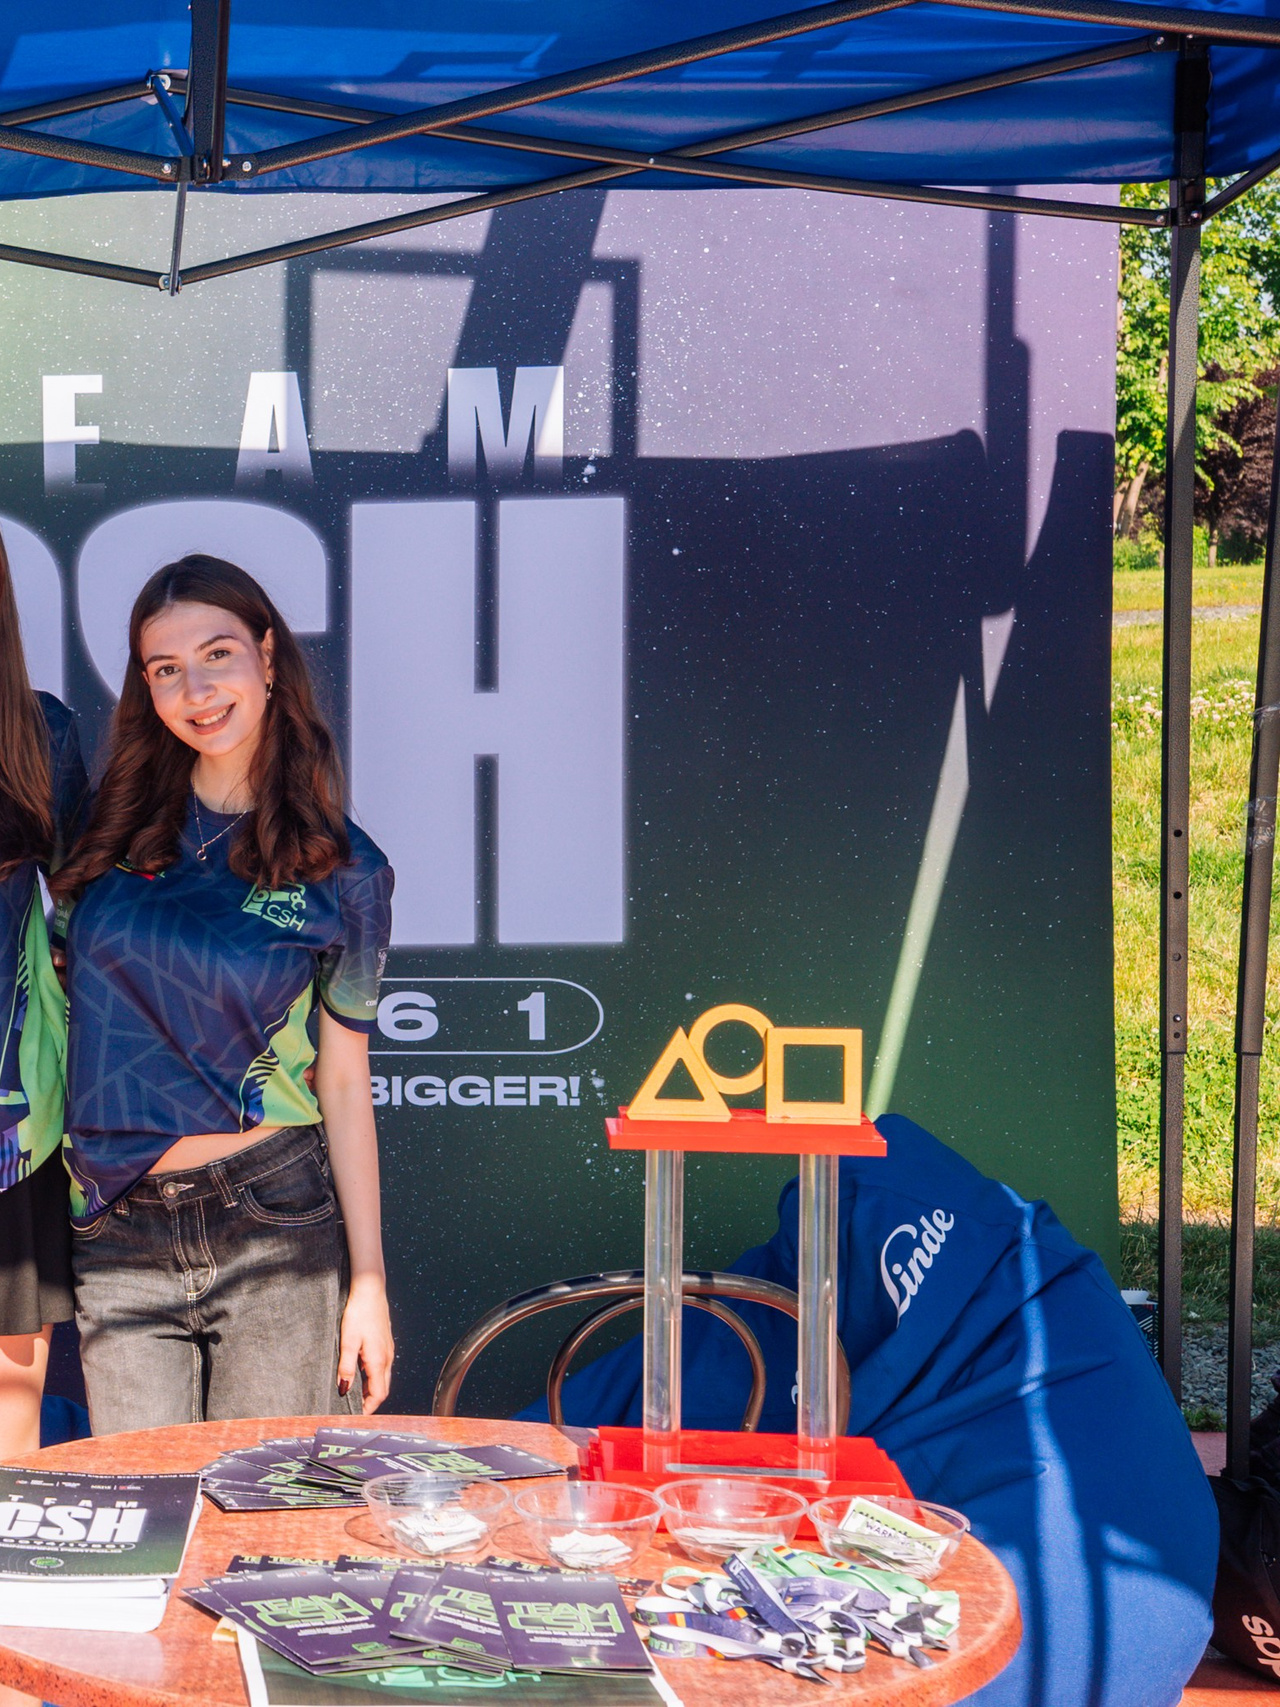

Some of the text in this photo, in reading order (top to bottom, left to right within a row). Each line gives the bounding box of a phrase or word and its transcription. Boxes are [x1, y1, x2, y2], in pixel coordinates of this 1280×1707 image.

[267, 904, 306, 931] CSH
[881, 1209, 954, 1329] Linde
[241, 1591, 361, 1613] TEAM
[502, 1601, 618, 1616] TEAM
[507, 1613, 625, 1633] CSH
